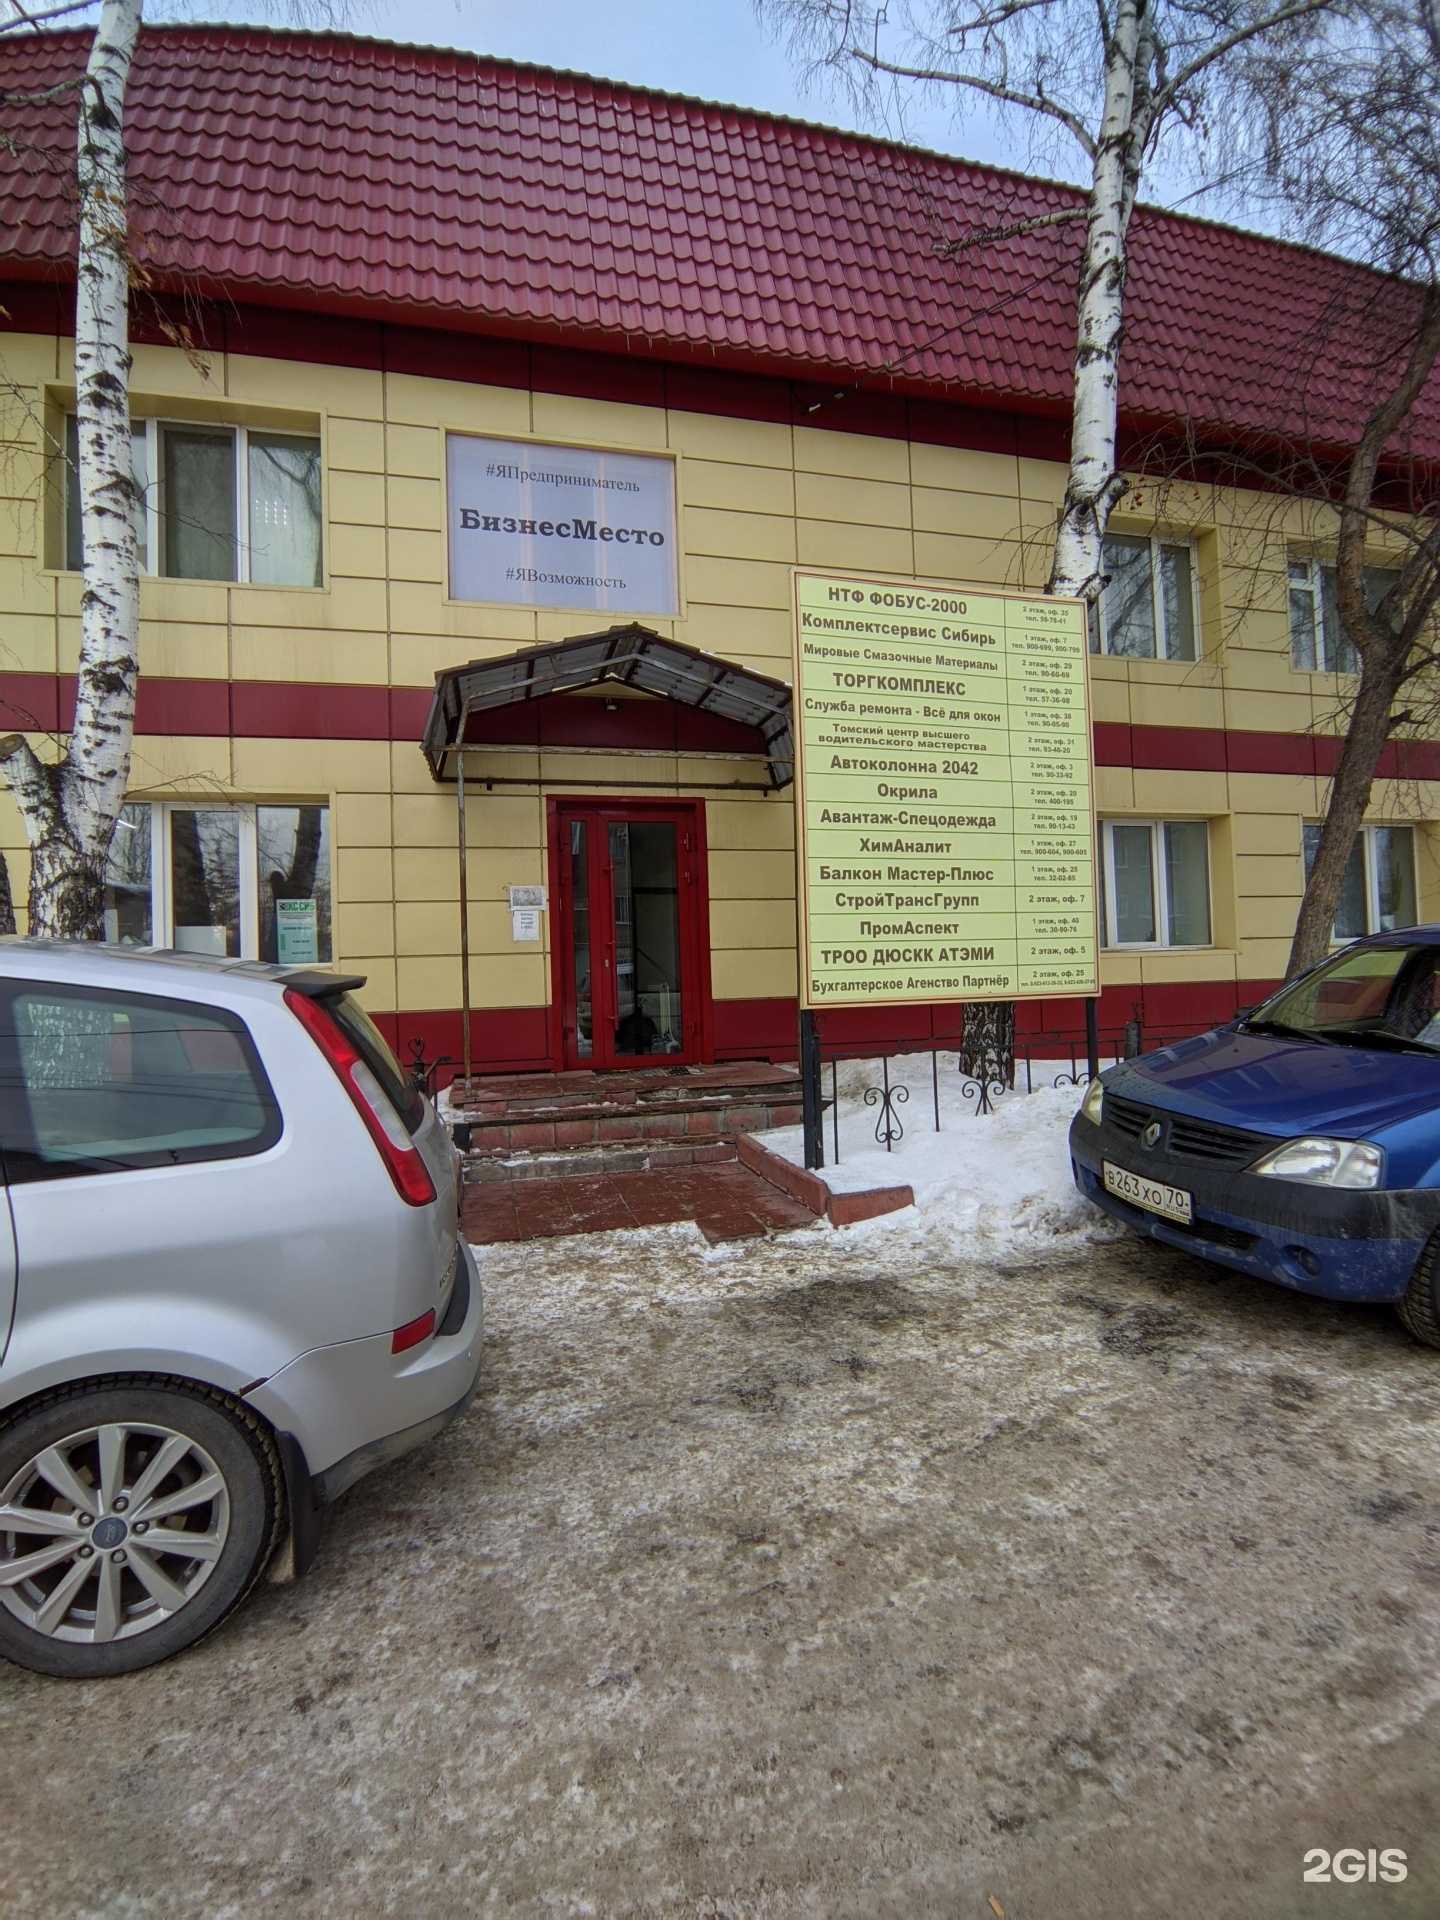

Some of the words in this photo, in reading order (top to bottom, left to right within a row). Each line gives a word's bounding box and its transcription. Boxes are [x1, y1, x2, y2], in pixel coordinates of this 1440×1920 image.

[485, 463, 640, 492] #ЯПредприниматель
[459, 508, 665, 547] БизнесМесто
[505, 567, 627, 589] #ЯВозможность
[828, 587, 864, 604] НТФ
[869, 591, 968, 615] ФОБУС-2000
[802, 612, 937, 639] Комплектсервис
[941, 626, 996, 647] Сибирь
[803, 643, 860, 658] Мировые
[863, 649, 932, 664] Смазочные
[936, 655, 998, 671] Материалы
[832, 671, 966, 695] ТОРГКОМПЛЕКС
[805, 698, 855, 713] Служба
[859, 703, 912, 716] ремонта
[923, 706, 945, 718] Всё
[949, 708, 970, 721] для
[973, 712, 1001, 723] окон
[832, 723, 883, 735] Томский
[887, 727, 919, 739] центр
[922, 730, 970, 741] высшего
[818, 734, 914, 748] водительского
[917, 740, 987, 752] мастерства
[830, 755, 937, 773] Автоколонна
[942, 760, 979, 775] 2042
[877, 783, 938, 801] Окрила
[820, 809, 996, 829] Авантаж-Спецодежда
[859, 837, 952, 853] ХимАналит
[820, 866, 882, 881] Балкон
[888, 866, 994, 884] Мастер-Плюс
[835, 892, 979, 910] СтройТрансГрупп
[1080, 894, 1085, 903] 7
[860, 921, 959, 938] ПромАспект
[821, 950, 868, 964] ТРОО
[873, 948, 934, 966] ДЮСКК
[938, 947, 995, 962] АТЭМИ
[1081, 946, 1086, 954] 5
[812, 978, 903, 994] Бухгалтерское
[906, 976, 959, 990] Агенство
[962, 974, 1009, 988] Партнёр
[1166, 1188, 1184, 1207] 70
